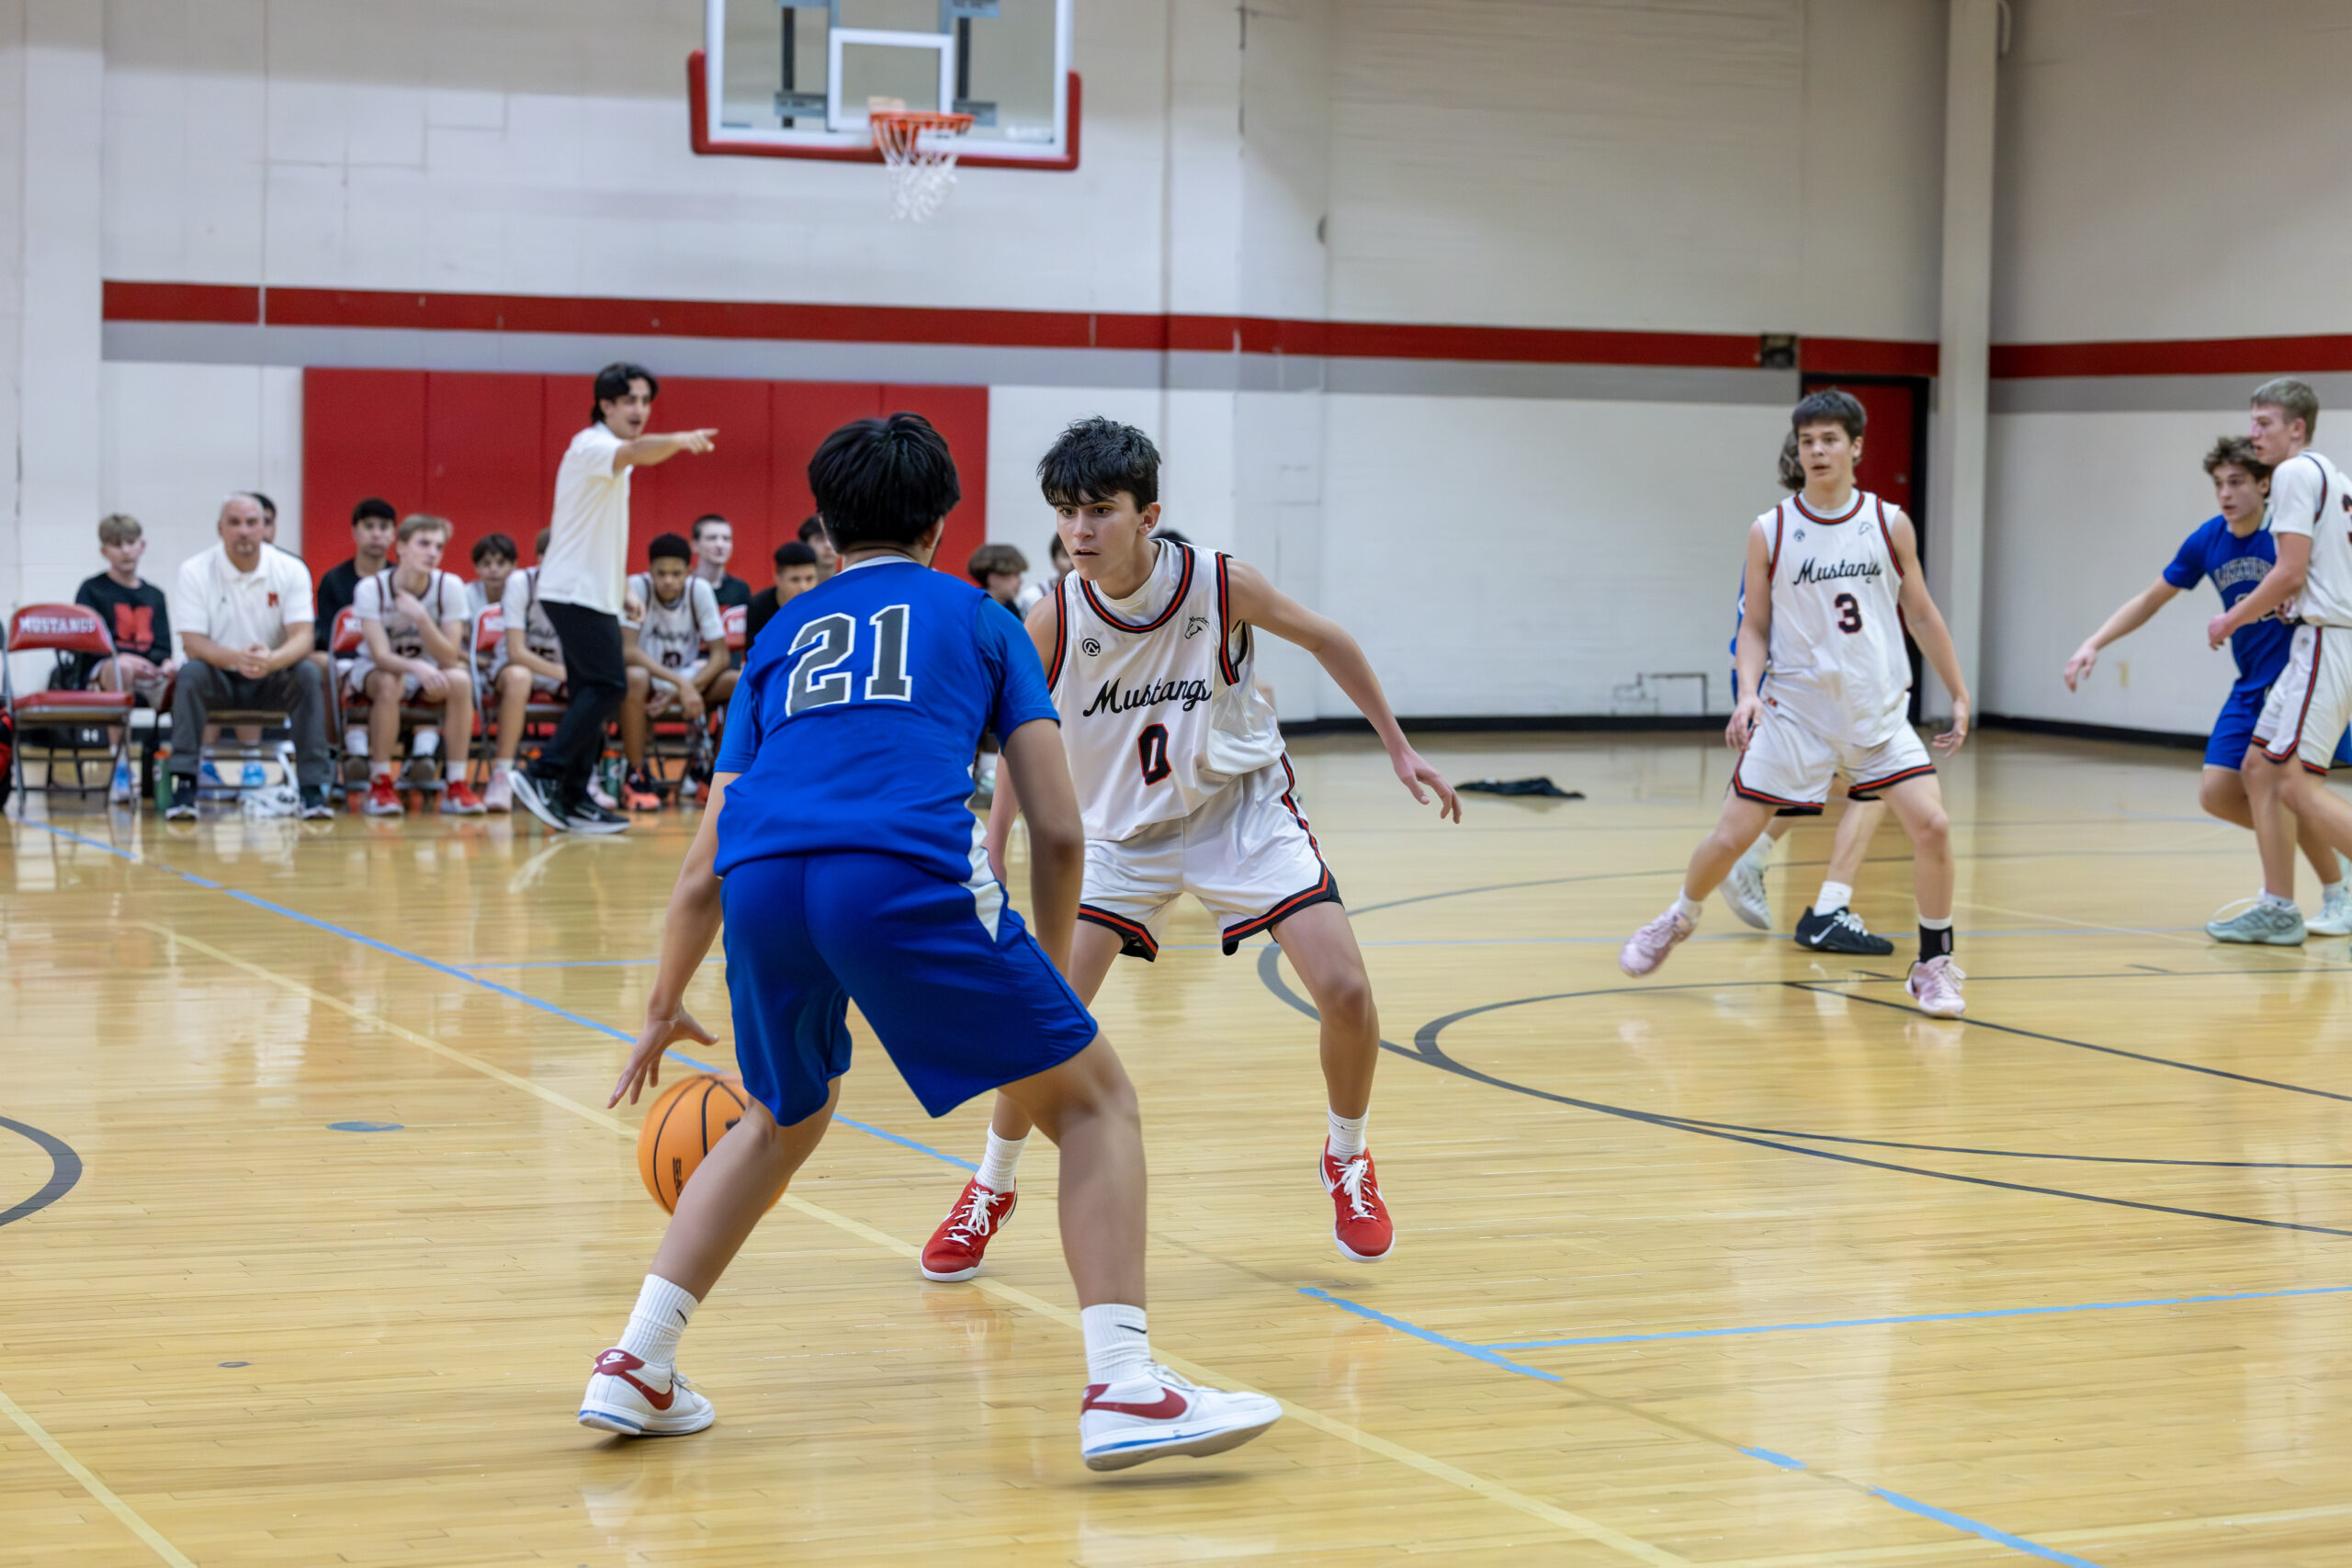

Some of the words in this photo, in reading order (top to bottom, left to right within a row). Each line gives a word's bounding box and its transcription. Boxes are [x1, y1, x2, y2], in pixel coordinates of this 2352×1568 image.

[113, 603, 154, 641] M
[1834, 592, 1863, 635] 3
[785, 604, 913, 717] 21
[1082, 677, 1213, 717] Mustangs
[1137, 723, 1172, 786] 0
